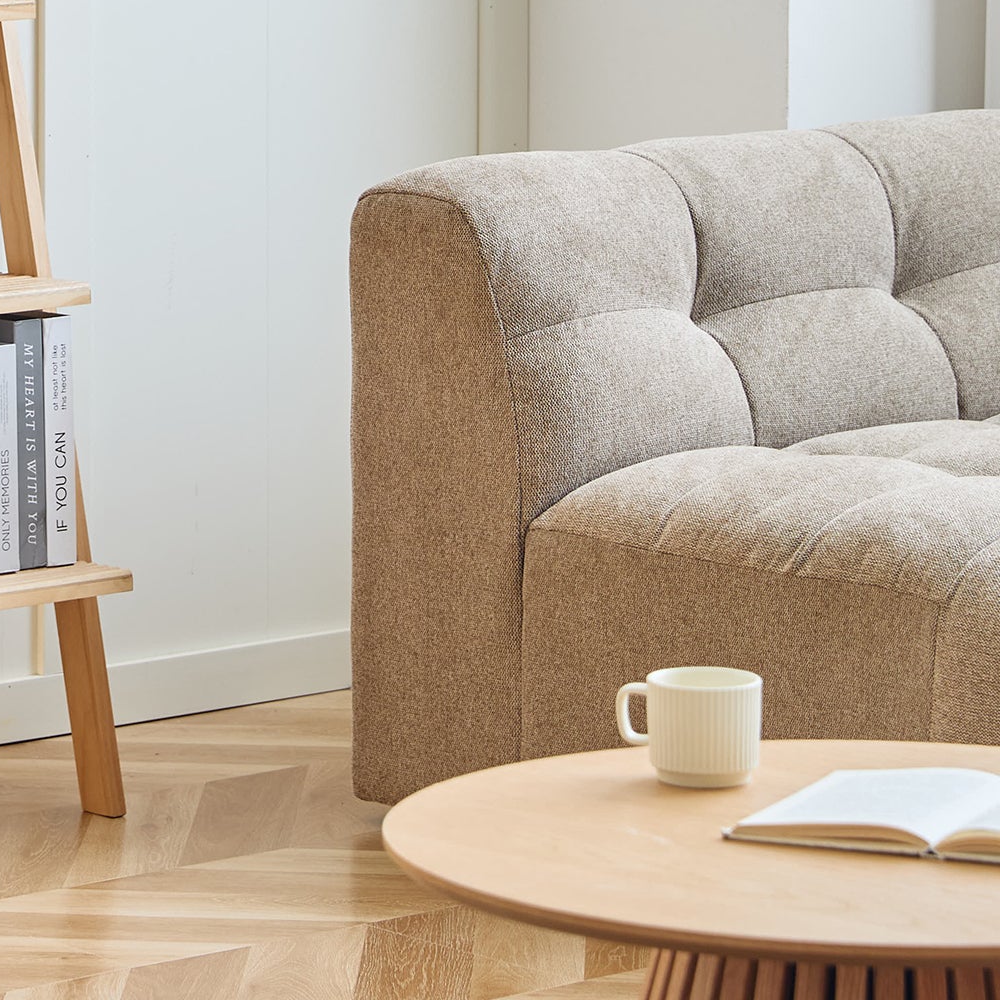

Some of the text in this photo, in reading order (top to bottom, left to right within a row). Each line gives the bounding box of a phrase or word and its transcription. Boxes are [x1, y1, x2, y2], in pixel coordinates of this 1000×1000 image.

[23, 343, 38, 545] MY HEART IS WITH YOU
[52, 402, 59, 411] at
[0, 449, 11, 551] ONLY MEMORIES
[54, 432, 68, 532] IF YOU CAN
